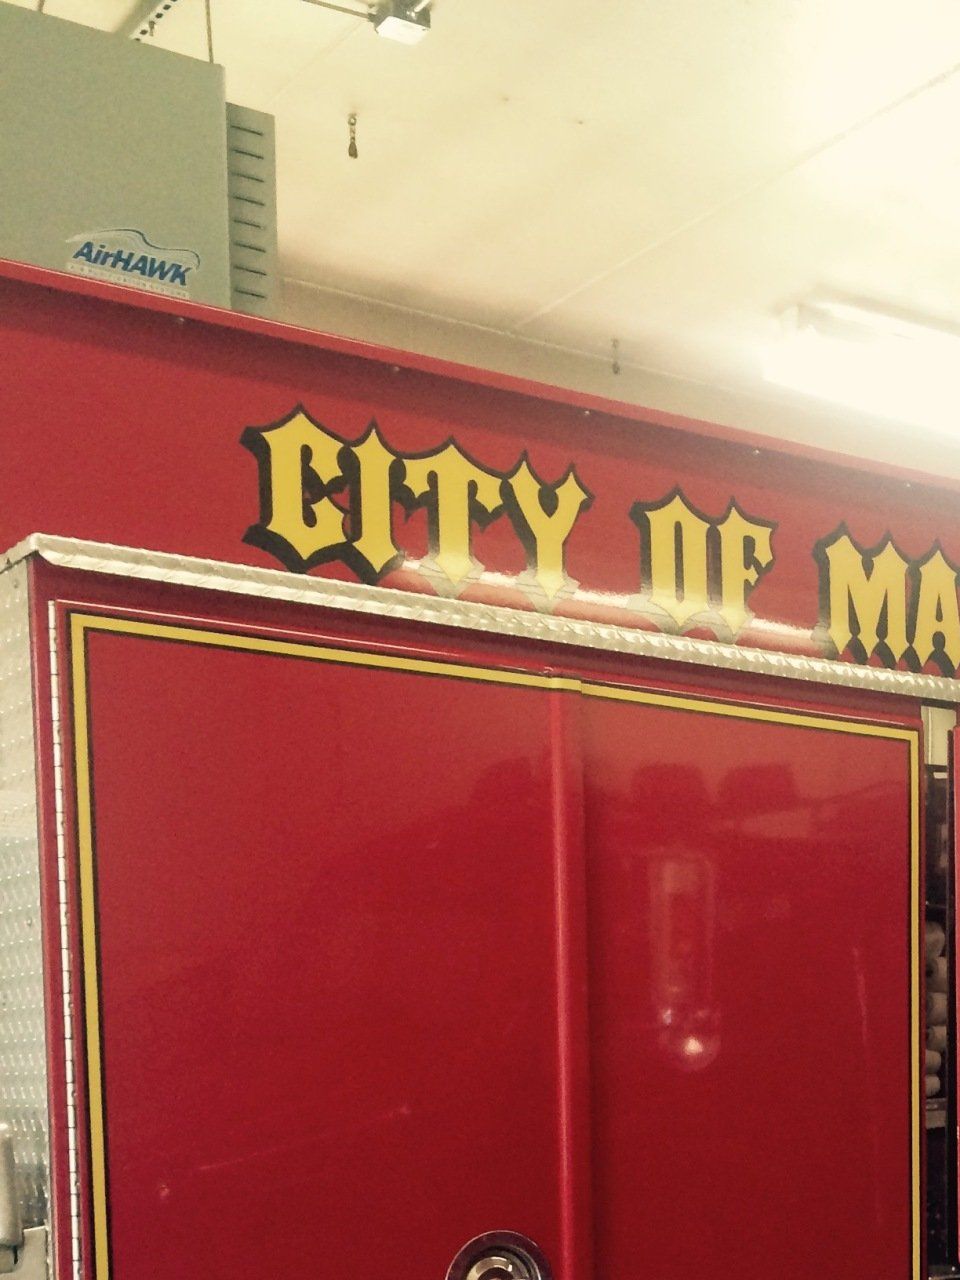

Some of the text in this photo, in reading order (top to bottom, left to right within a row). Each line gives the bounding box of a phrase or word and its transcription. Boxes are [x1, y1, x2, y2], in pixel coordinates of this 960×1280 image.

[72, 241, 193, 286] AirHAWK
[241, 404, 594, 612] CITY
[630, 486, 778, 643] OF
